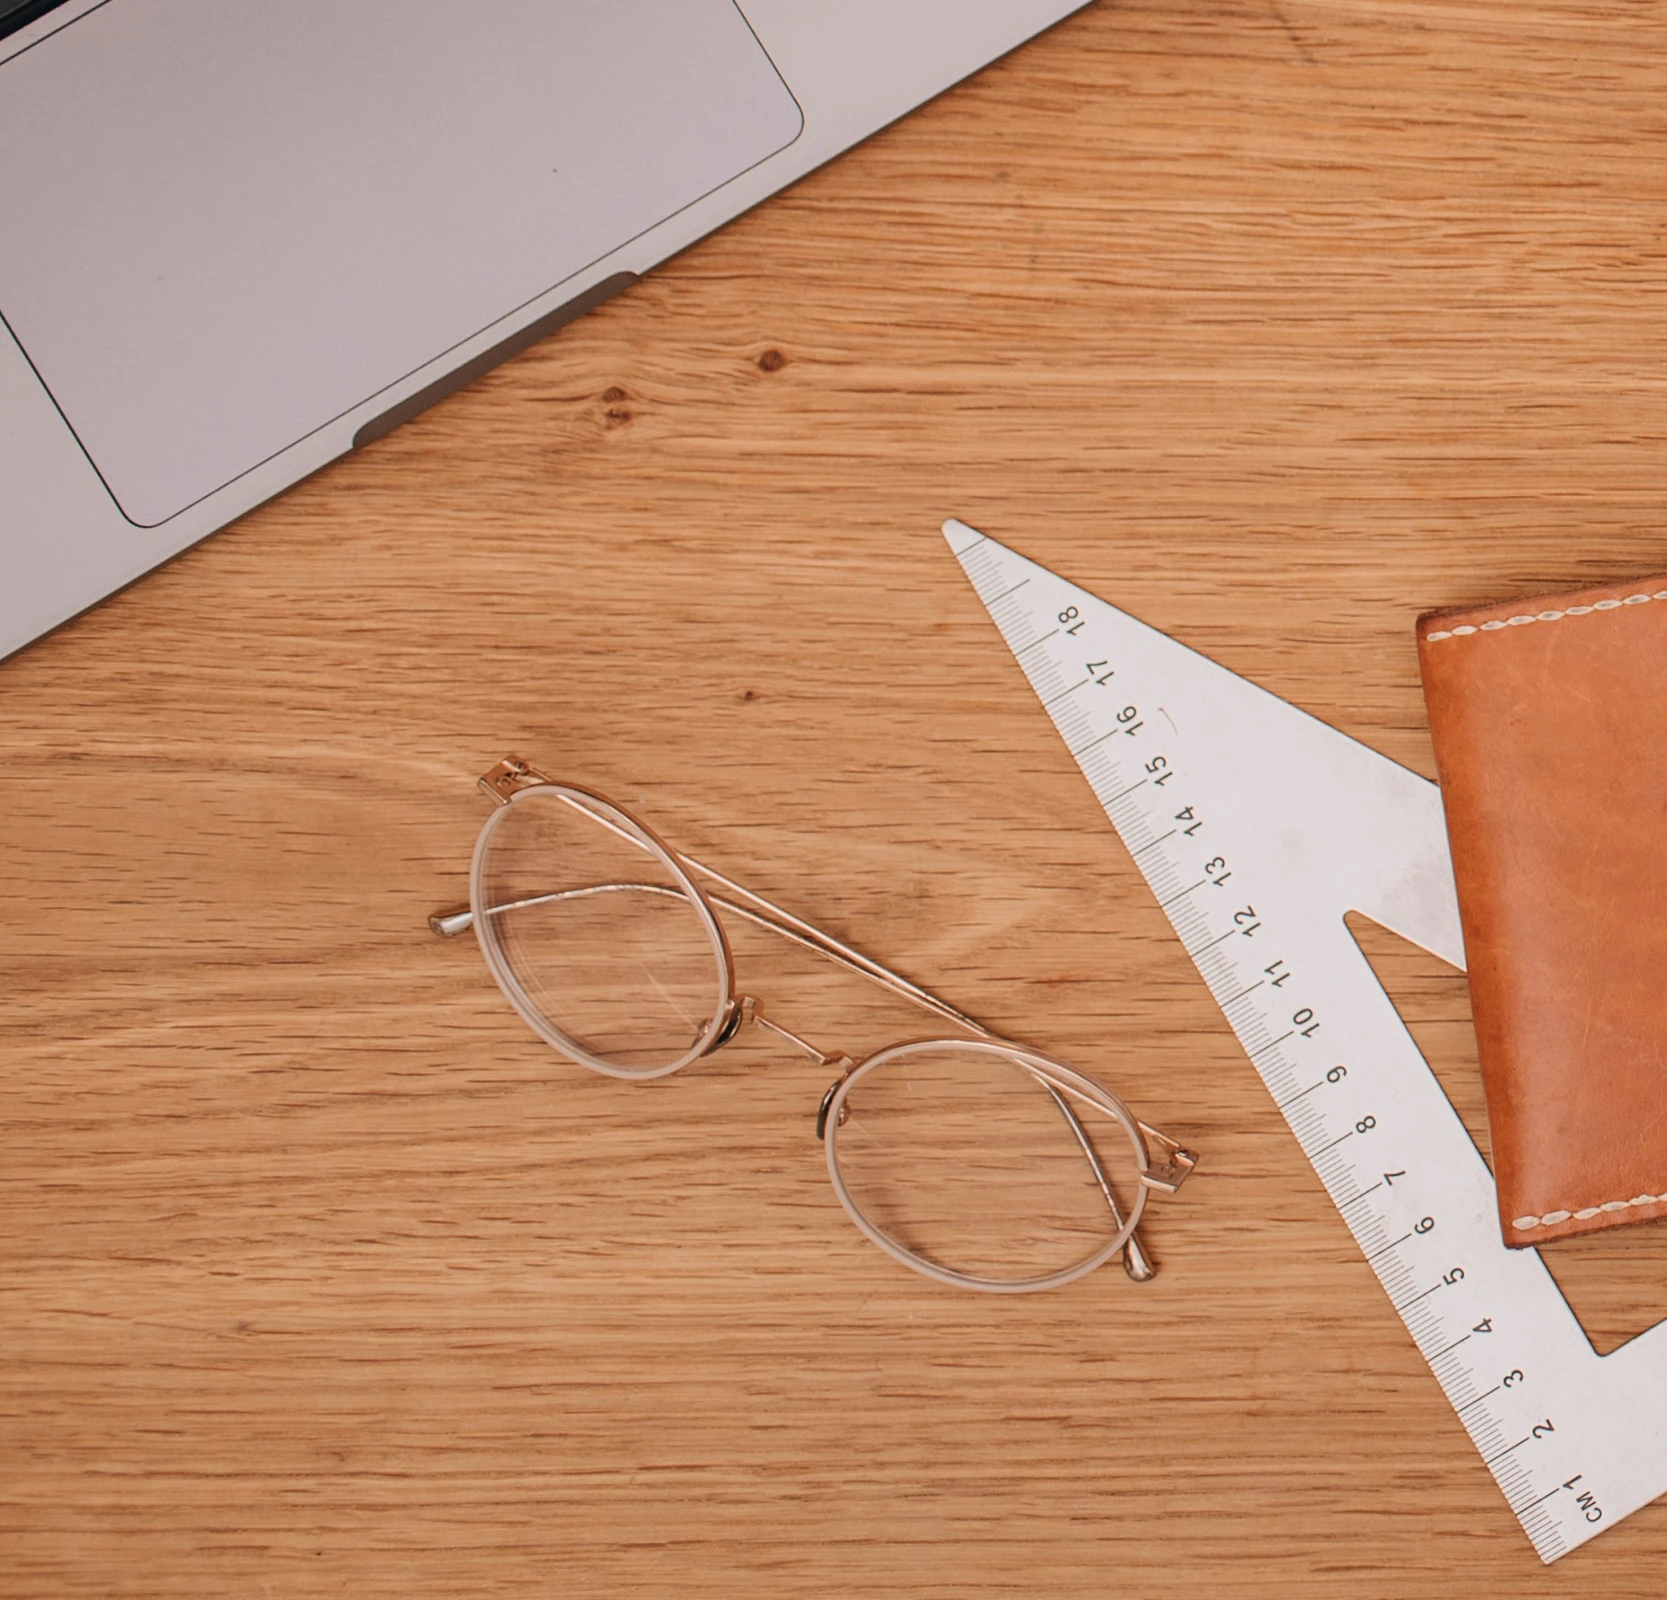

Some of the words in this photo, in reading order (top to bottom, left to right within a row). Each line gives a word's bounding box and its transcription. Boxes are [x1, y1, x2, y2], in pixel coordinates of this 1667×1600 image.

[1058, 605, 1086, 636] 18
[1085, 657, 1115, 687] 17
[1116, 705, 1144, 737] 16
[1144, 755, 1174, 787] 15
[1173, 804, 1203, 837] 14
[1204, 856, 1232, 887] 13
[1233, 905, 1262, 938] 12
[1263, 959, 1291, 988] 11
[1292, 1007, 1320, 1039] 10
[1326, 1065, 1348, 1084] 9
[1355, 1115, 1377, 1134] 8
[1383, 1169, 1407, 1187] 7
[1413, 1216, 1435, 1235] 6
[1442, 1267, 1465, 1286] 5
[1472, 1316, 1494, 1335] 4
[1502, 1369, 1524, 1388] 3
[1531, 1418, 1555, 1440] 2
[1562, 1473, 1584, 1491] 1
[1575, 1490, 1603, 1523] CM
